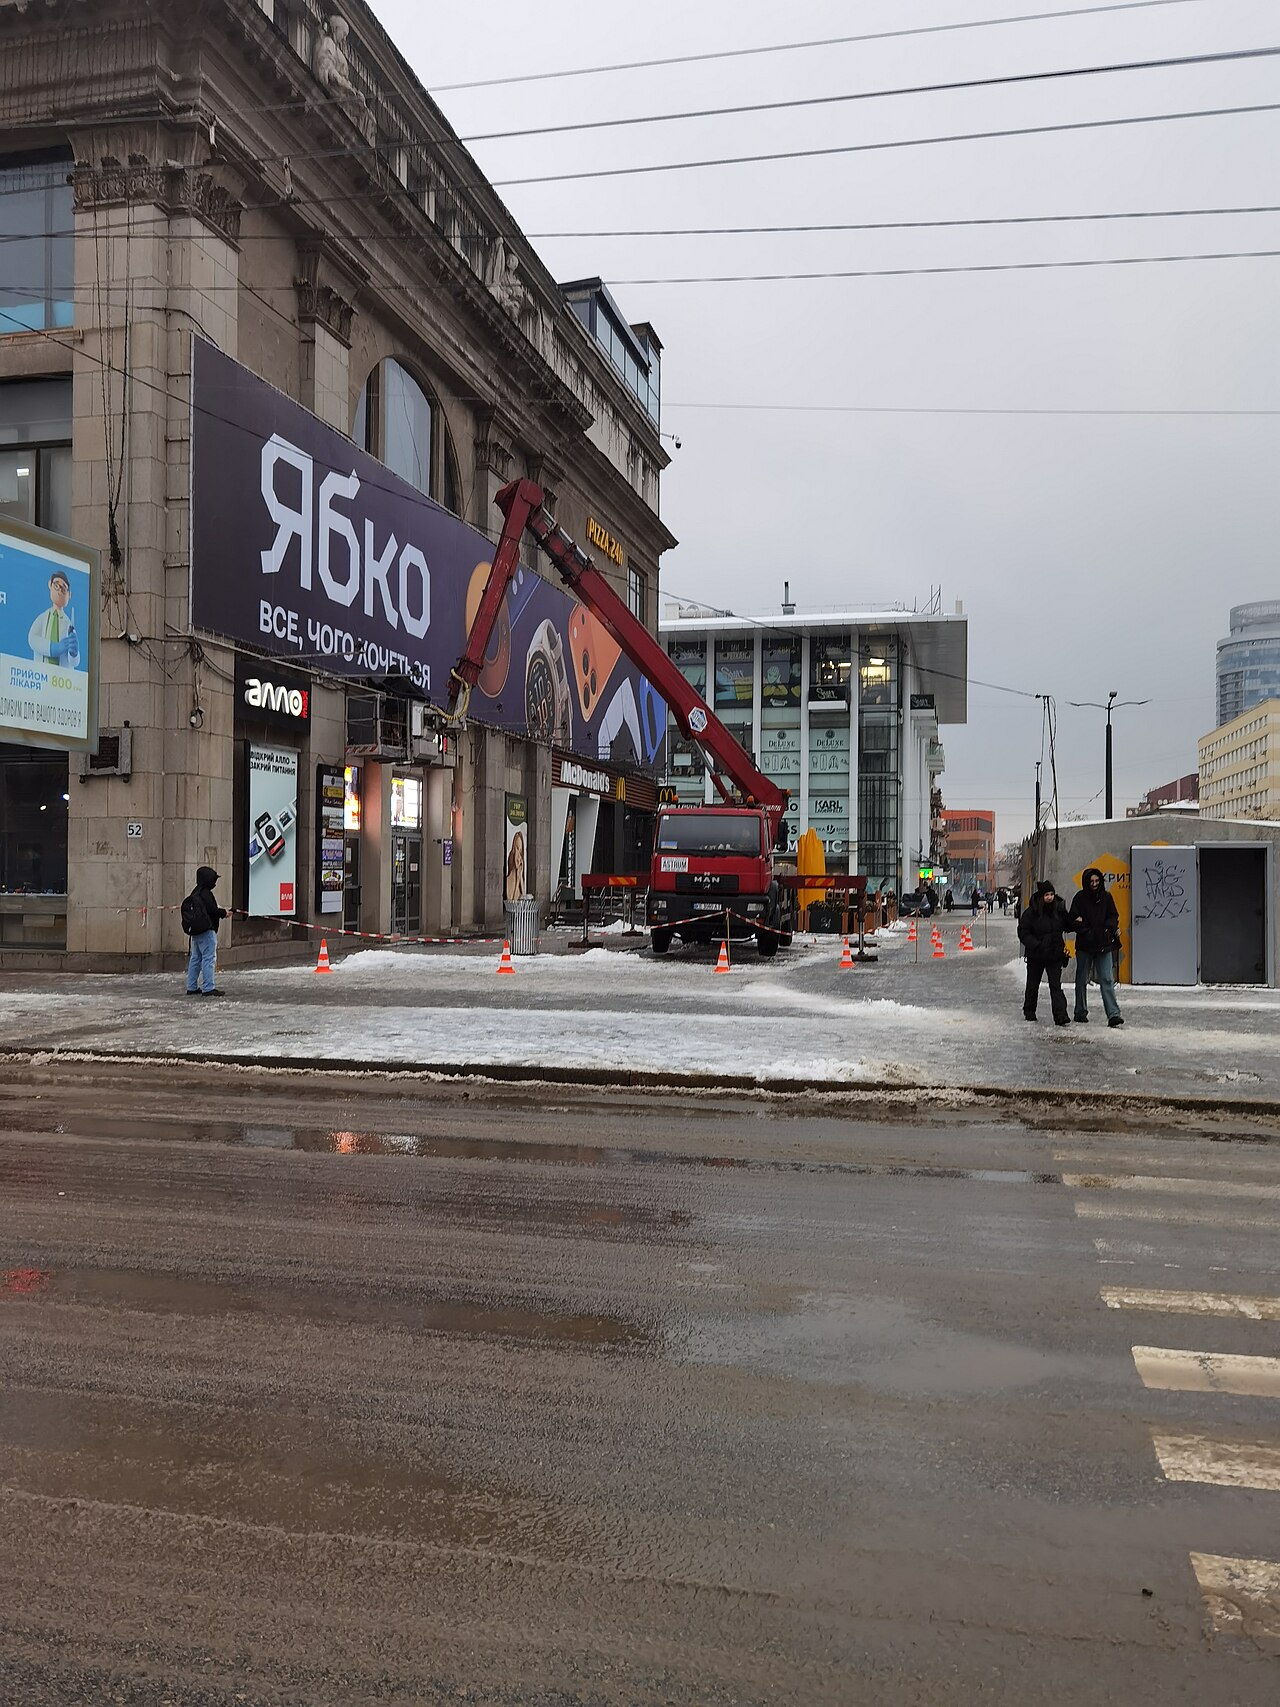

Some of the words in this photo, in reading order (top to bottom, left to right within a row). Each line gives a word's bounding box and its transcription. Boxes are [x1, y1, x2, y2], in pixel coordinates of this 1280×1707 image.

[260, 432, 431, 640] ЯБКО
[586, 516, 609, 554] PIZZA
[259, 599, 304, 651] ВСЕ,
[307, 617, 355, 663] ЧОГО
[10, 666, 48, 682] ПРИЙОМ
[10, 677, 41, 690] ЛІКАРЯ
[51, 675, 72, 690] 800
[560, 760, 610, 793] McDonald's
[814, 800, 843, 809] KARL
[128, 825, 142, 836] 52
[662, 860, 687, 869] ASTRUM
